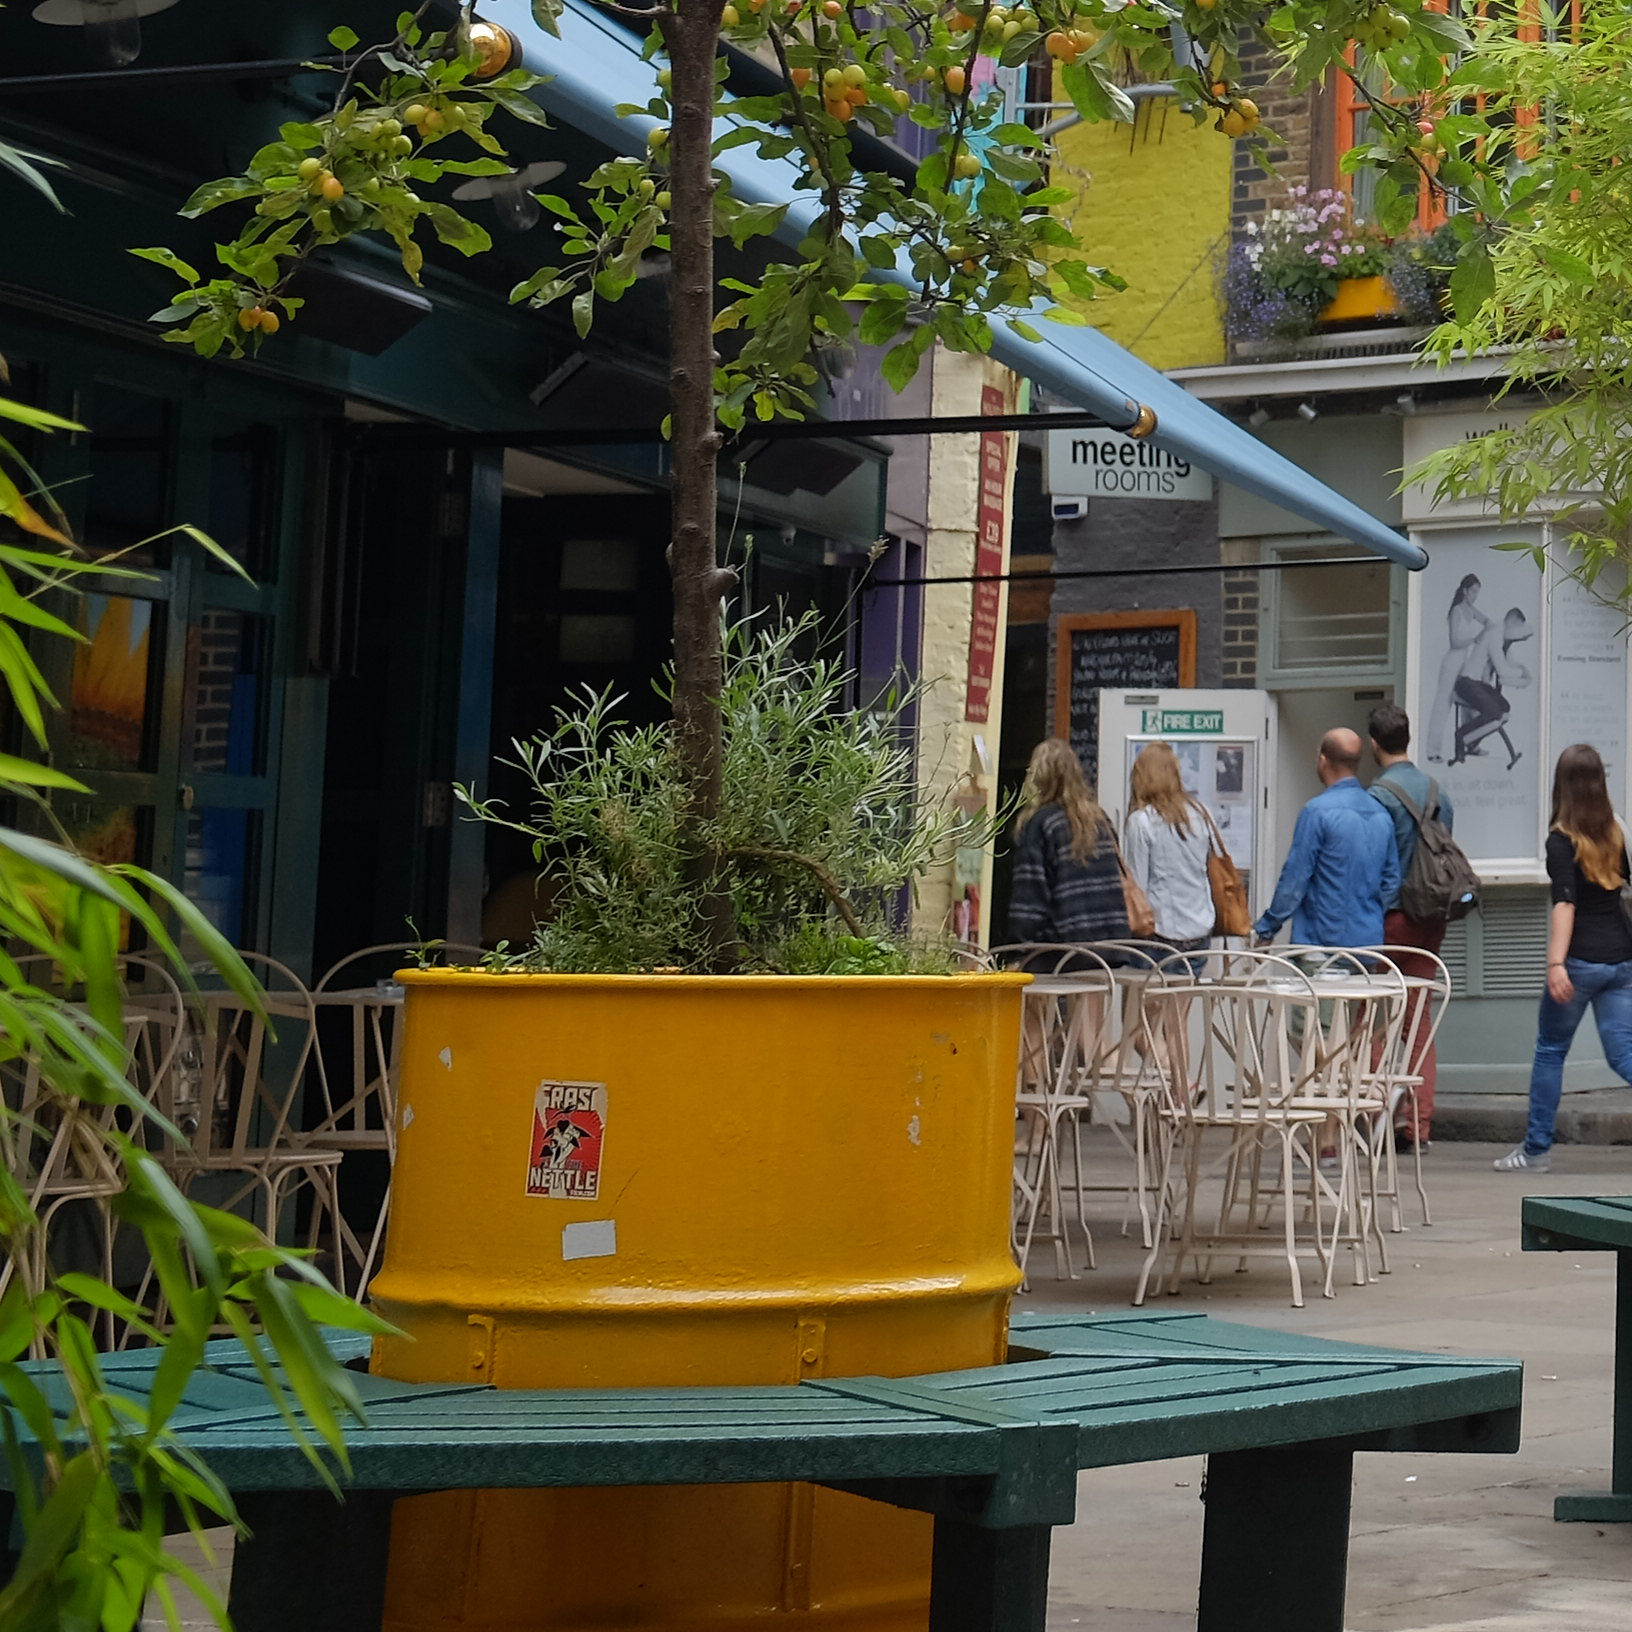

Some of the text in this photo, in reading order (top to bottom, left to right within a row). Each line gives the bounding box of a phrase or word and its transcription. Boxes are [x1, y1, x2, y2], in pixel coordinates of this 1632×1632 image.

[1072, 438, 1191, 478] meeting
[1095, 468, 1176, 494] rooms
[1557, 654, 1621, 664] Evening Standard
[1164, 714, 1222, 729] FIRE EXIT
[530, 1167, 597, 1191] NETTLE
